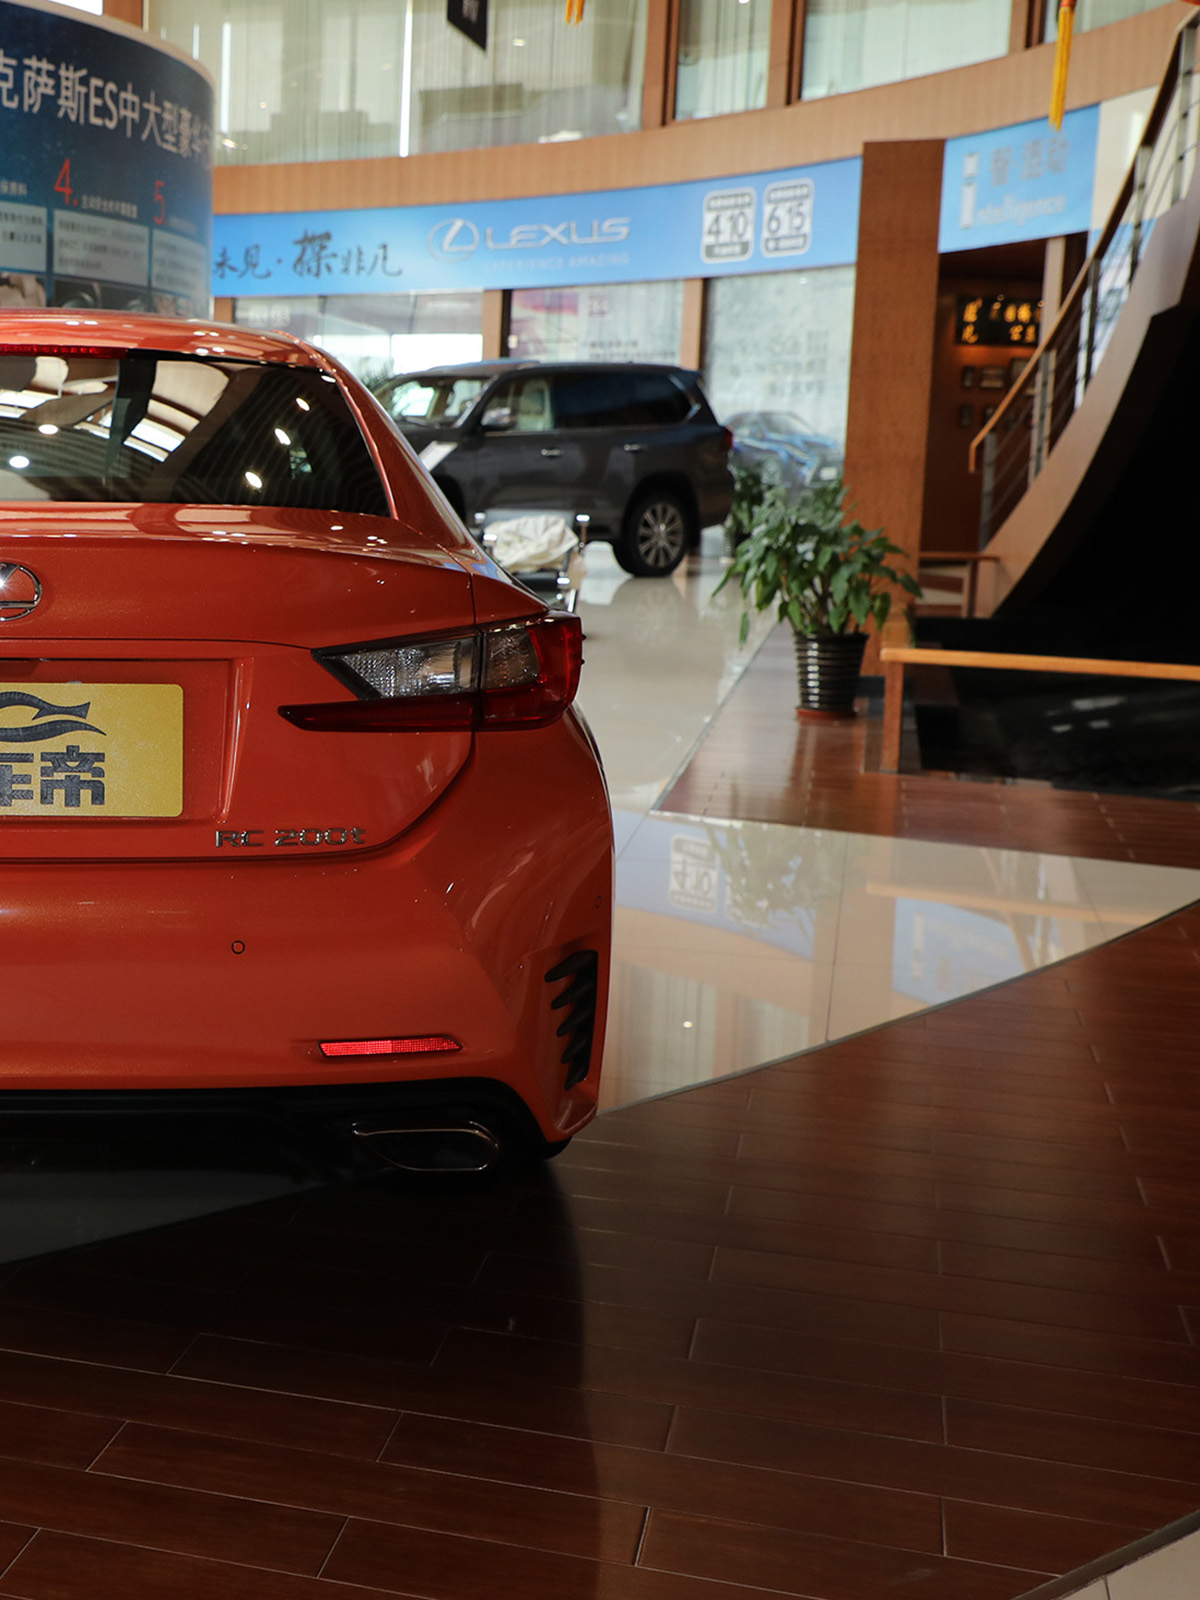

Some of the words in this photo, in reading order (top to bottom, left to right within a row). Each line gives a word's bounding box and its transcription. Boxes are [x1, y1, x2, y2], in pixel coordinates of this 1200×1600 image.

[486, 217, 631, 250] LEXUS
[215, 830, 264, 848] RC
[274, 827, 367, 847] 200t
